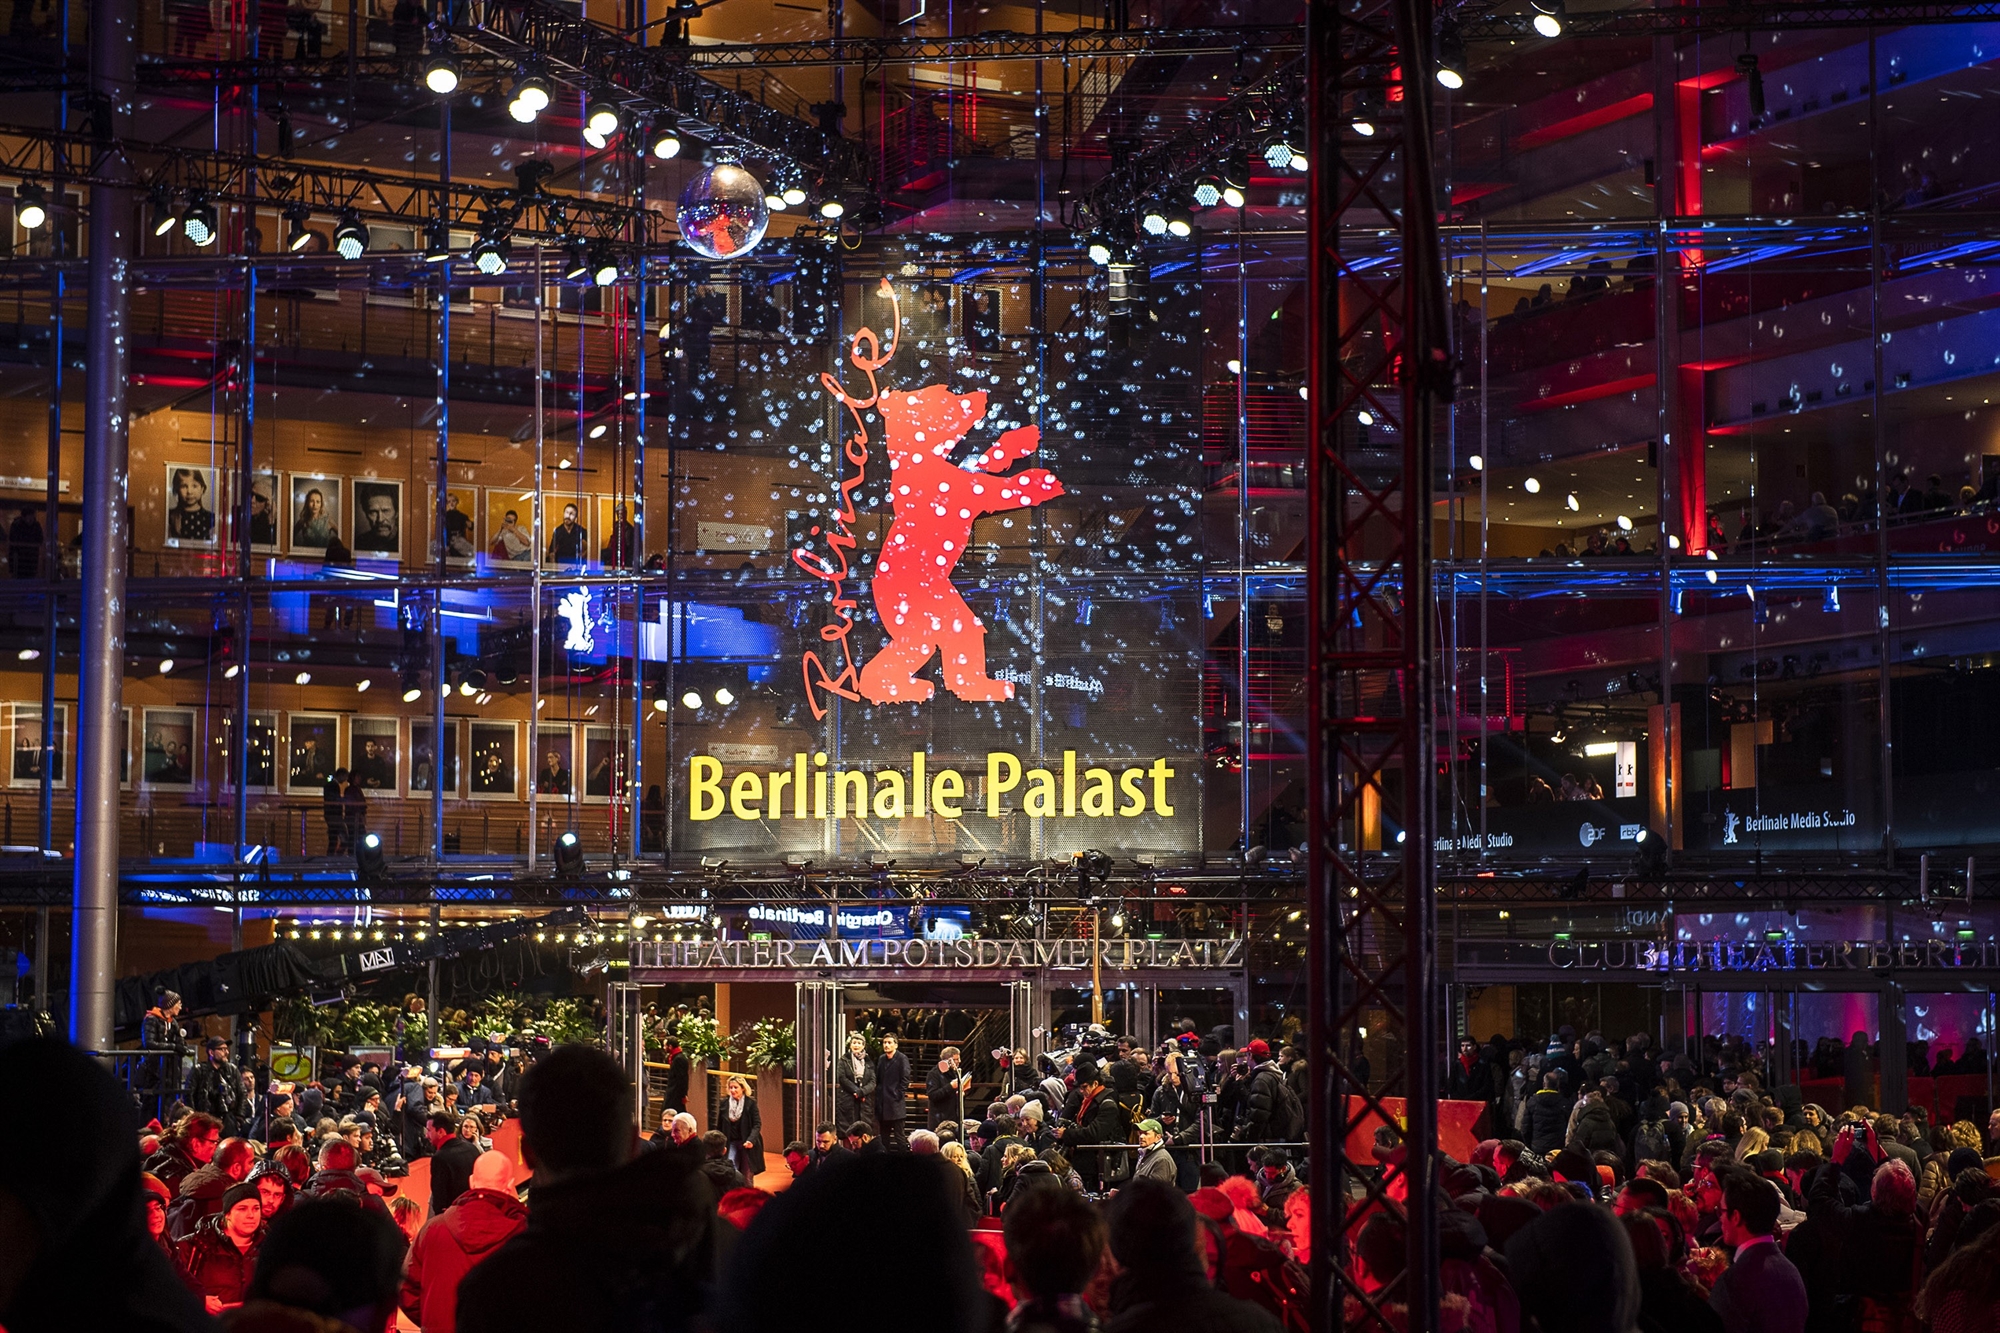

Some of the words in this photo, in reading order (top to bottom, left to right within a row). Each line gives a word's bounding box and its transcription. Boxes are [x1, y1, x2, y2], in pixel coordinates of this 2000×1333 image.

[690, 752, 965, 820] Berlinale
[987, 750, 1175, 817] Palast
[1746, 813, 1789, 832] Berlinale
[1790, 811, 1821, 829] Media
[1823, 809, 1855, 827] Sio
[1433, 835, 1461, 851] erlinae
[1462, 834, 1483, 850] Medi
[1487, 832, 1514, 849] Studio
[1587, 827, 1606, 841] ZDF
[361, 948, 393, 970] MAT
[630, 939, 797, 968] THEATER
[808, 938, 875, 968] AM
[882, 938, 1116, 968] POTSDAMER
[1125, 938, 1245, 968] PLATZ
[1549, 939, 1656, 969] CLUB
[1666, 939, 1857, 970] THEATER
